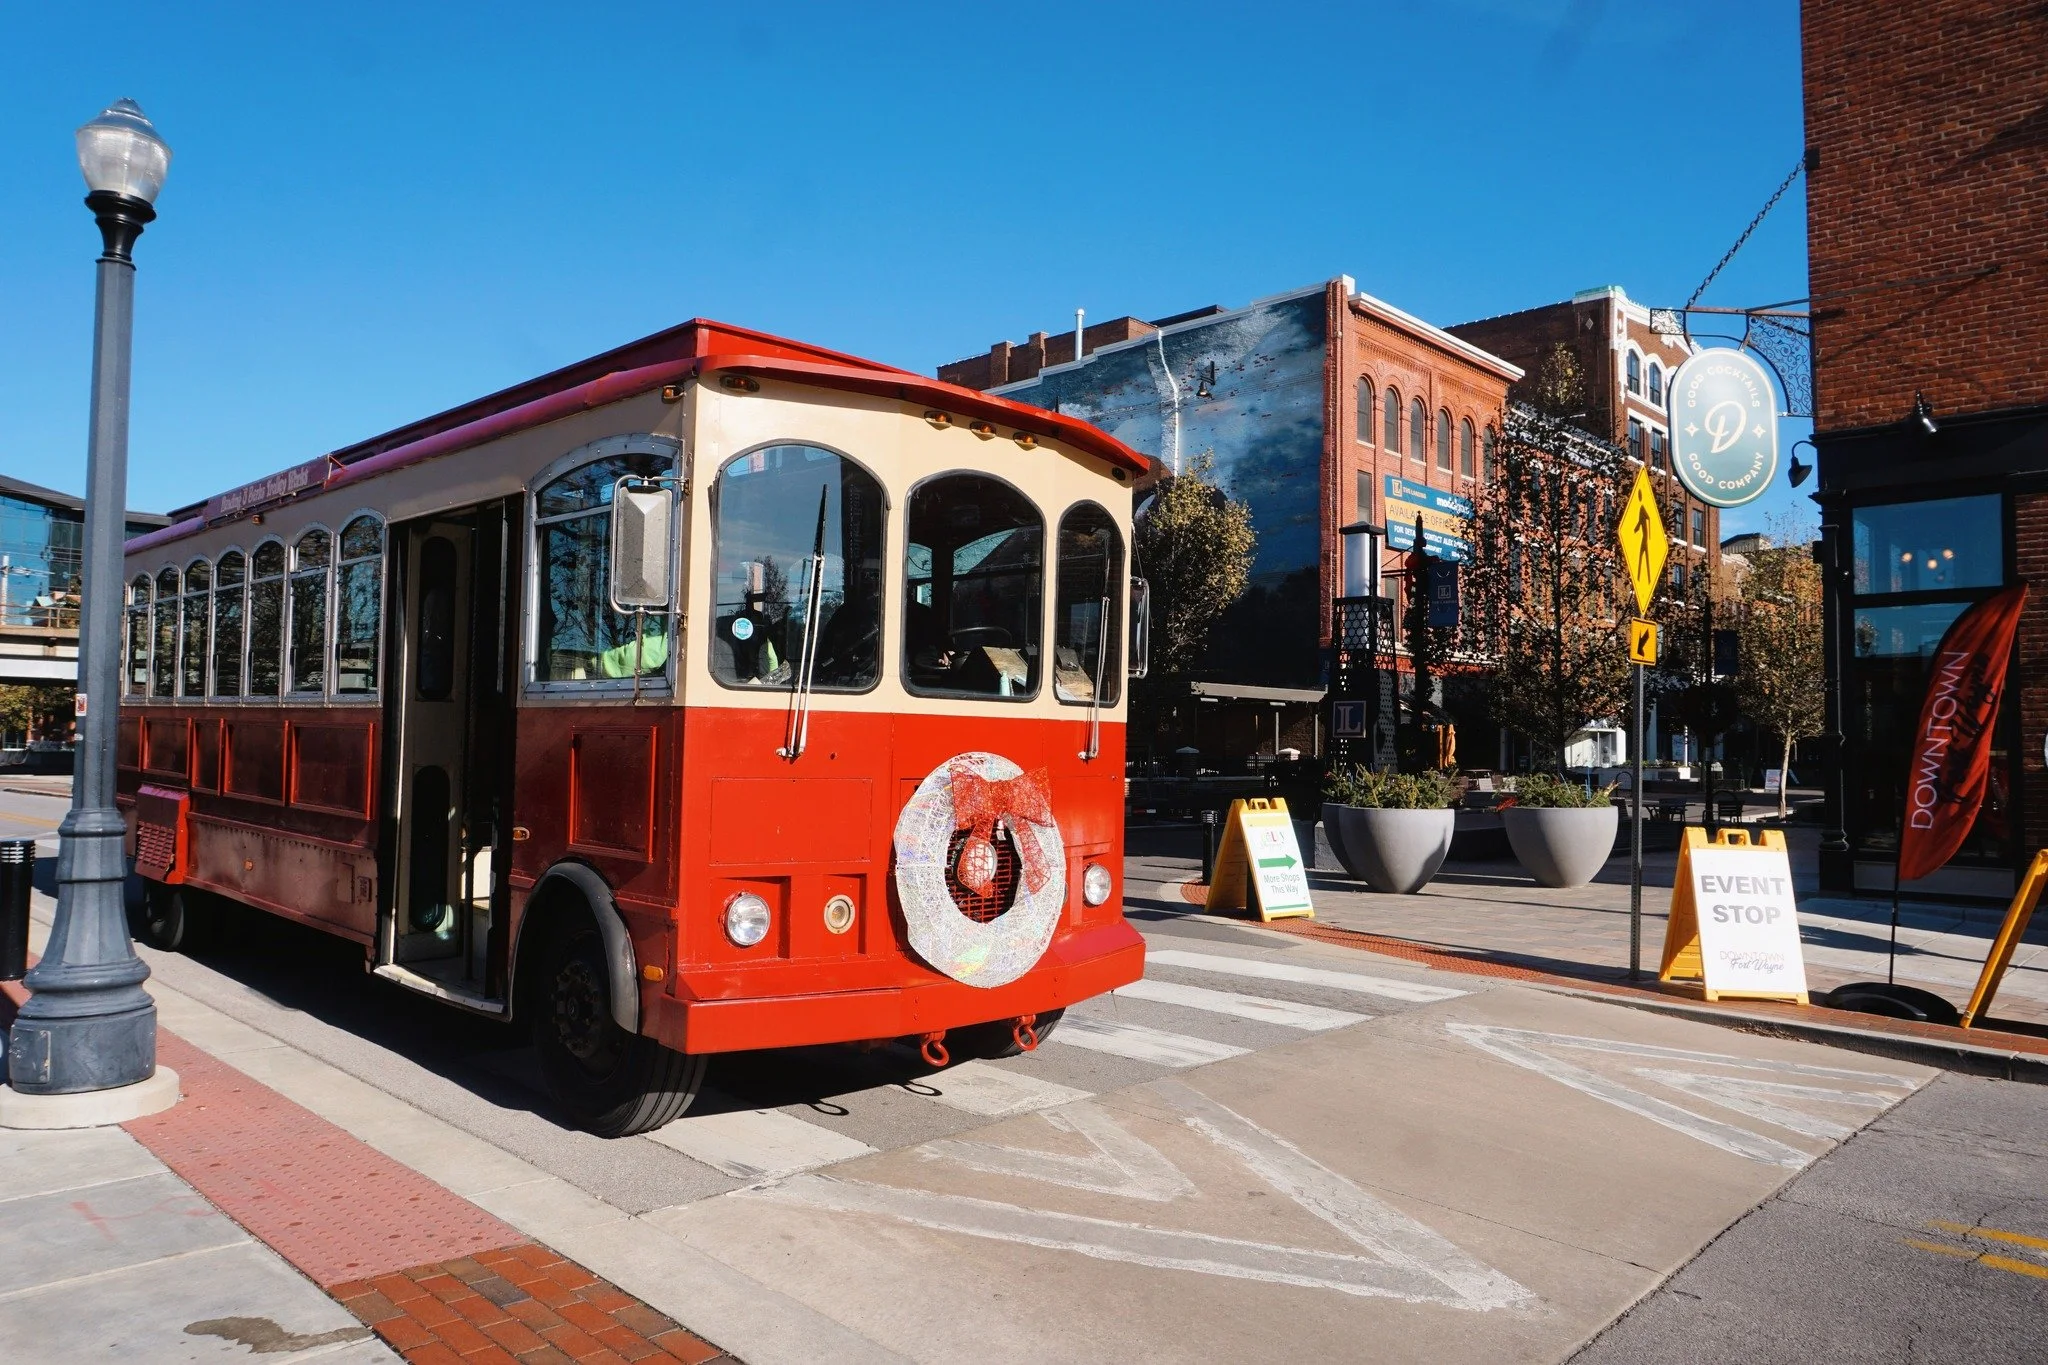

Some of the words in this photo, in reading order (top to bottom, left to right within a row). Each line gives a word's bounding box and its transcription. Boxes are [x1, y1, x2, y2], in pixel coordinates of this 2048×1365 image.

[1688, 373, 1704, 408] GOOD
[1707, 365, 1760, 408] COCKTAILS
[1689, 453, 1714, 485] GOOD
[1718, 452, 1764, 489] COMPANY
[1389, 504, 1429, 524] AVAILAE
[1911, 651, 1970, 829] DOWNTOWN
[1263, 874, 1280, 884] More
[1281, 872, 1300, 883] Shops
[1701, 875, 1785, 896] EVENT
[1270, 885, 1285, 894] This
[1285, 884, 1299, 895] Way
[1712, 904, 1781, 924] STOP
[1720, 950, 1784, 962] DOWNTOWN
[1730, 957, 1752, 970] Fort
[1752, 958, 1784, 974] Wayne
